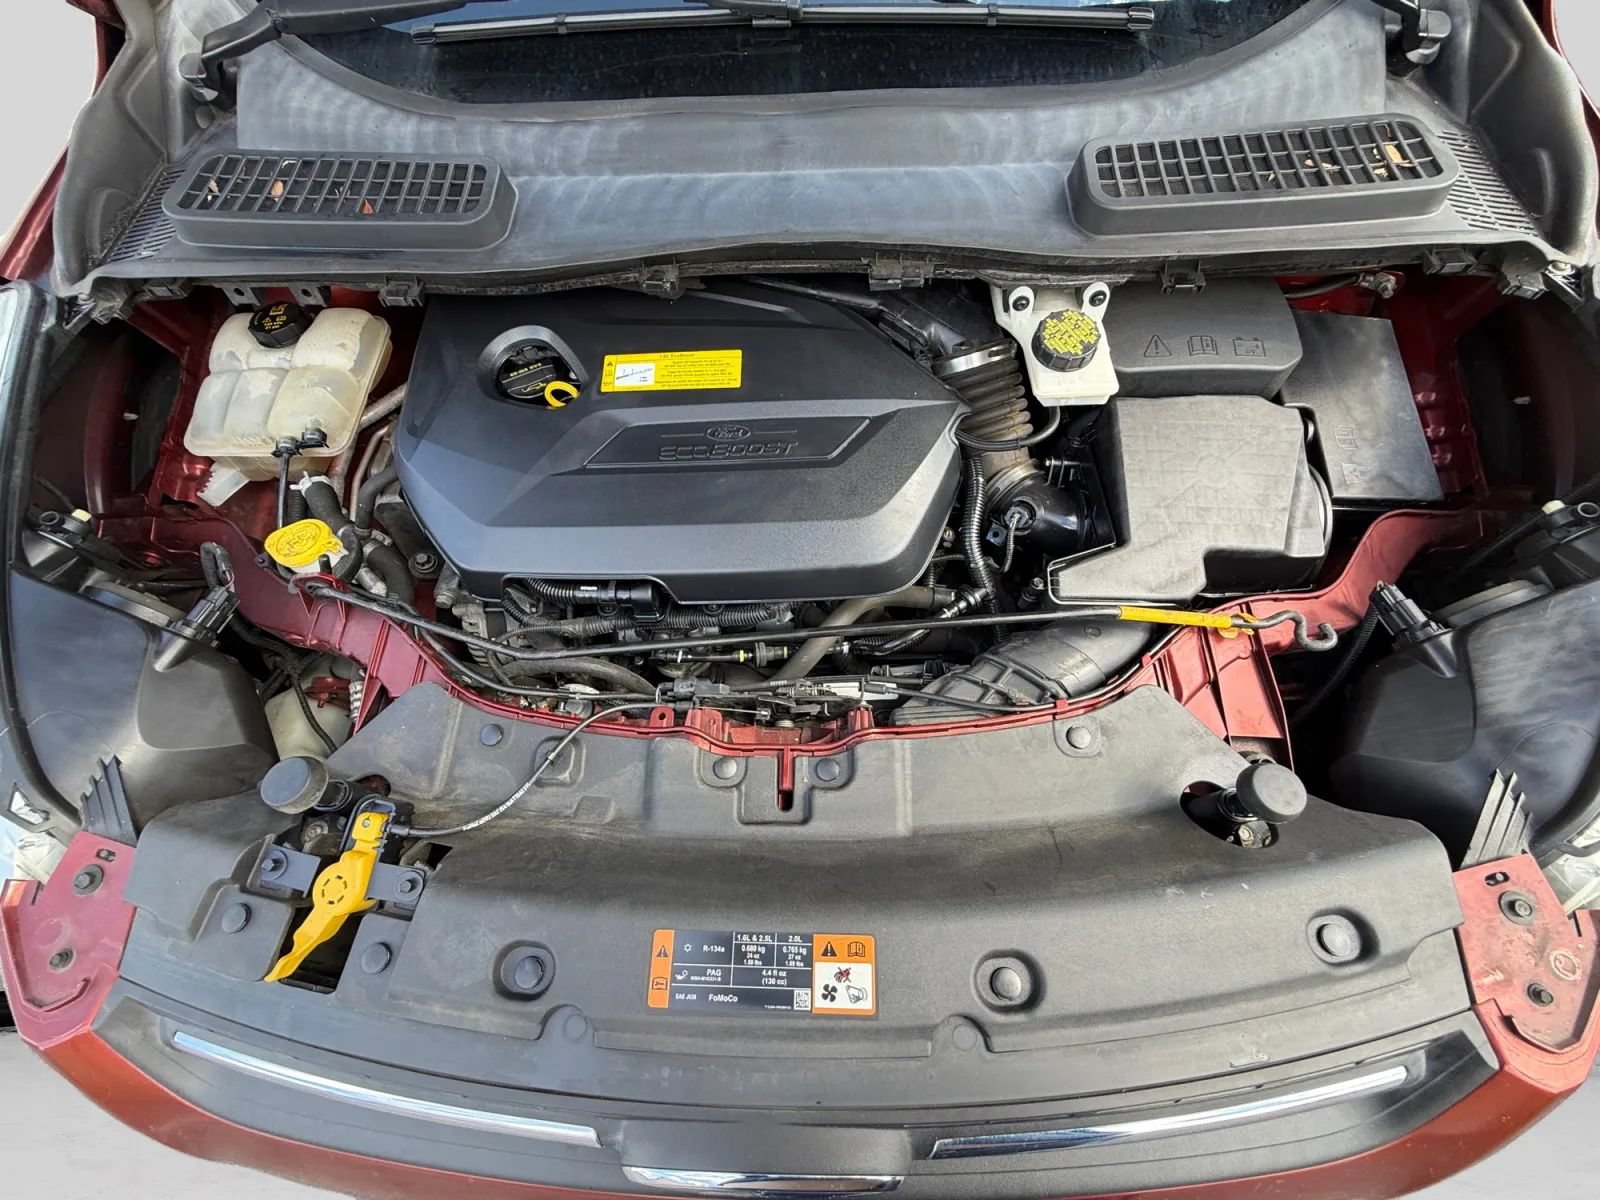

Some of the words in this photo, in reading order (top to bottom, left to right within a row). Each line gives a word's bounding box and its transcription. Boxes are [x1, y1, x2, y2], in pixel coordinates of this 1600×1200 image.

[737, 934, 751, 942] 1.6L
[752, 934, 758, 942] &
[788, 935, 803, 943] 2.0L
[702, 944, 726, 953] R-134a
[757, 944, 766, 954] kg
[782, 945, 799, 954] 0.765
[799, 946, 807, 955] kg
[706, 968, 722, 977] PAG
[762, 977, 776, 986] (130
[777, 978, 788, 986] cc)
[708, 993, 739, 1003] FoMoCo
